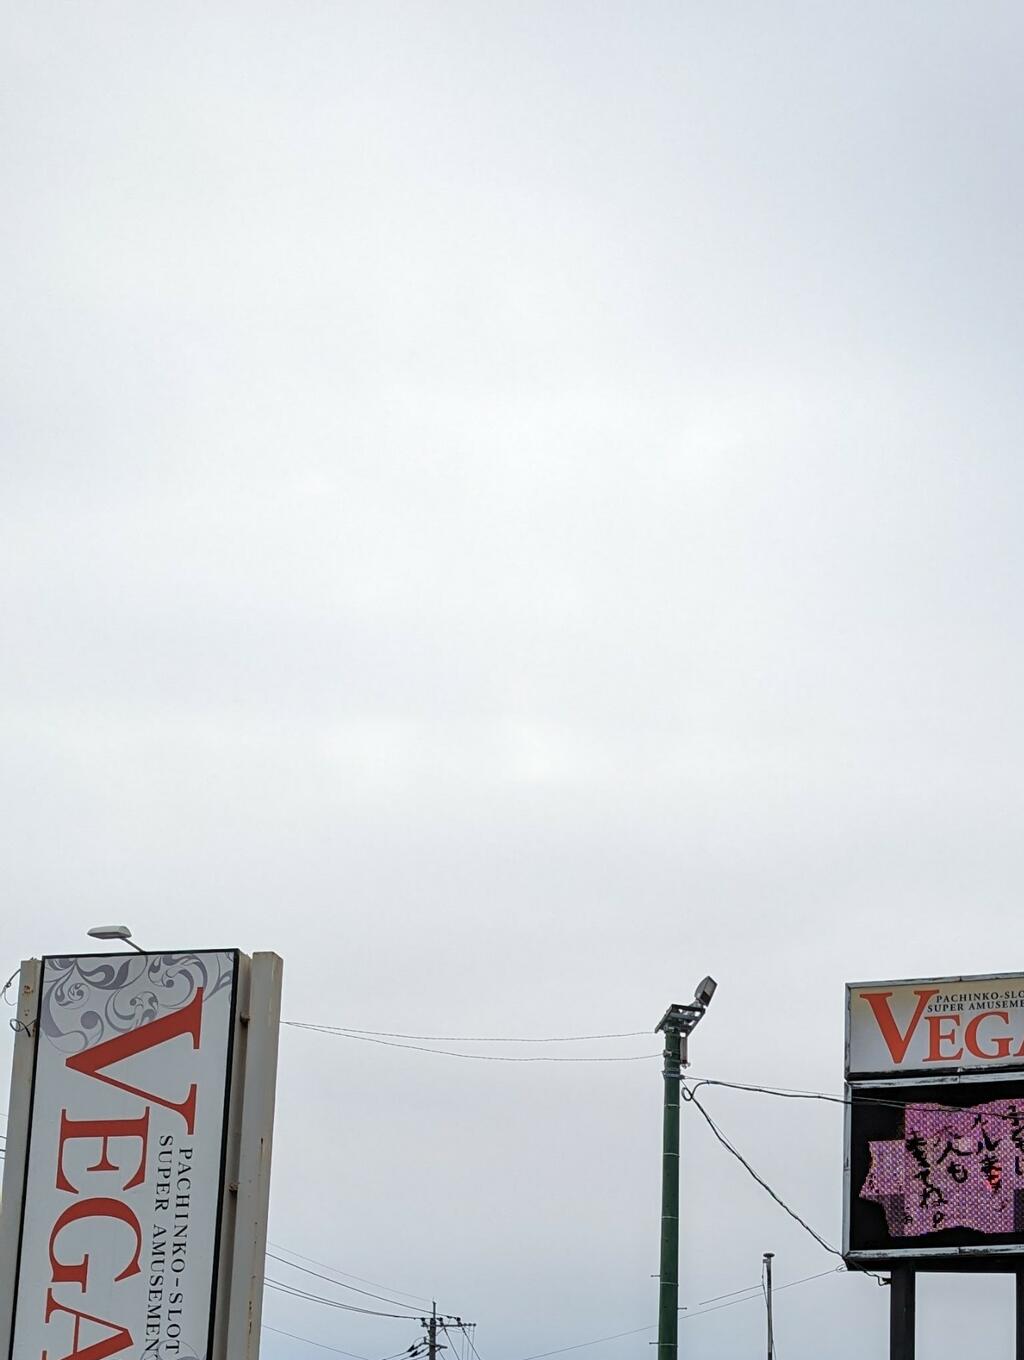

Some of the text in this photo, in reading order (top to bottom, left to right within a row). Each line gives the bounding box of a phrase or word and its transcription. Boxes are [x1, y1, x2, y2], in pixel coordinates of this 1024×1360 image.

[926, 1002, 965, 1014] SUPER
[154, 1134, 175, 1213] SUPER
[165, 1147, 194, 1355] PACHINKO-SLOT
